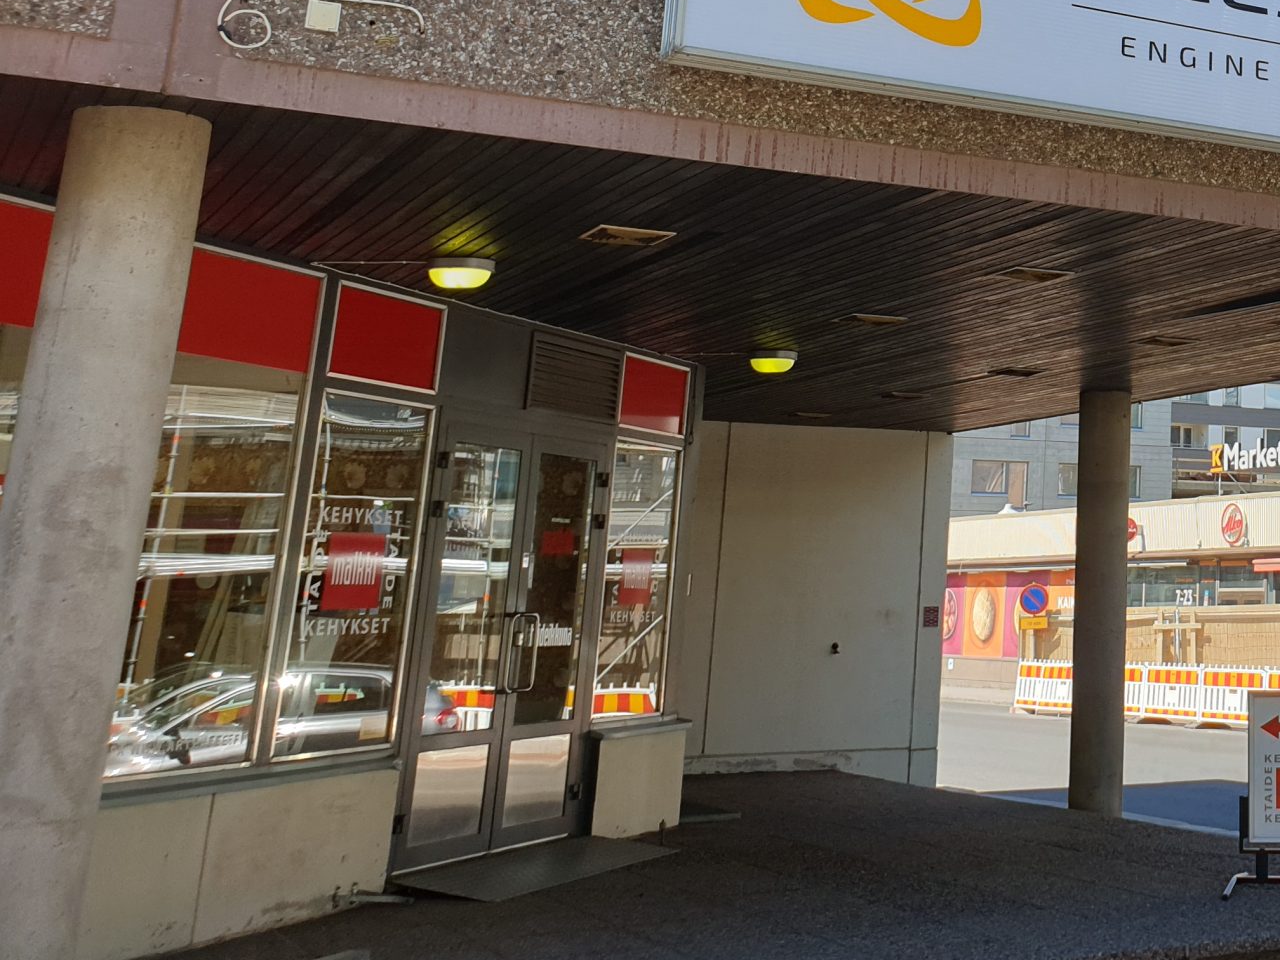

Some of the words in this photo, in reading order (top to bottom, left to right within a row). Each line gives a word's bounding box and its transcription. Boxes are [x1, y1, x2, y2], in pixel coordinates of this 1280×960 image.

[320, 505, 404, 527] KEHYKSET
[304, 617, 391, 637] KEHYKSET
[610, 610, 657, 624] KEHYSET
[1264, 766, 1272, 812] TAIDE
